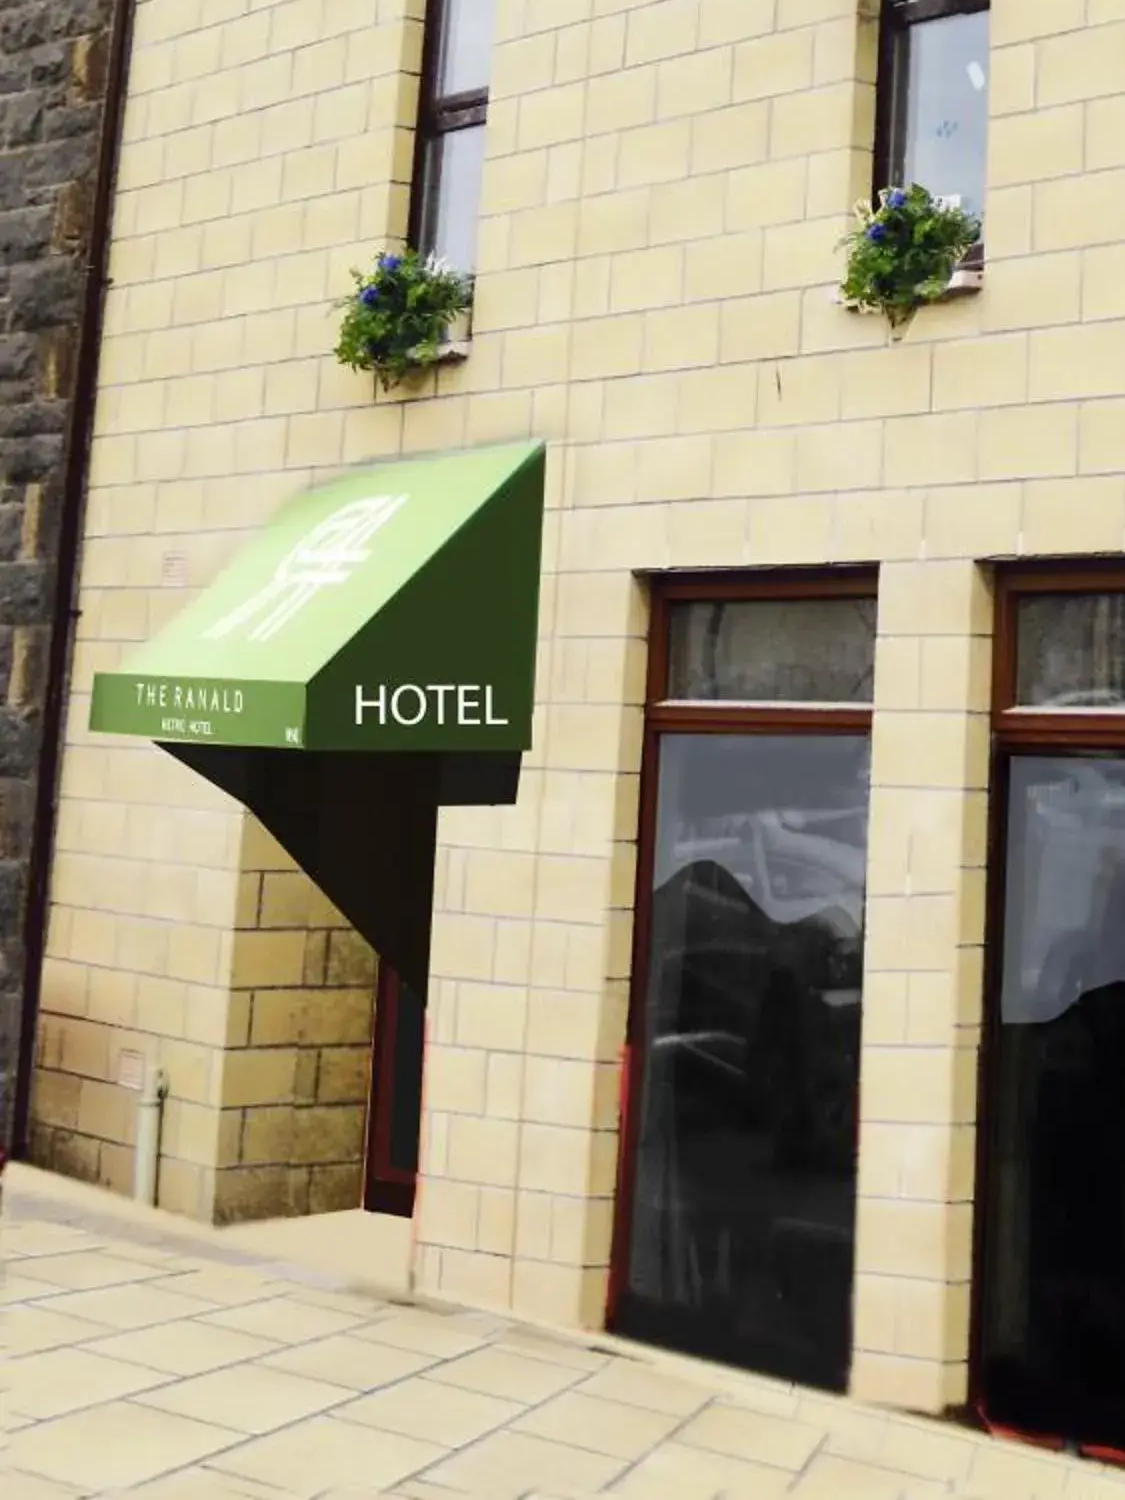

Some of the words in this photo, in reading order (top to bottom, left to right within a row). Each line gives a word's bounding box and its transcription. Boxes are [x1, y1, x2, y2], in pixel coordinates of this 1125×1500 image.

[136, 683, 168, 707] THE
[173, 685, 244, 713] RANALD
[355, 685, 509, 725] HOTEL
